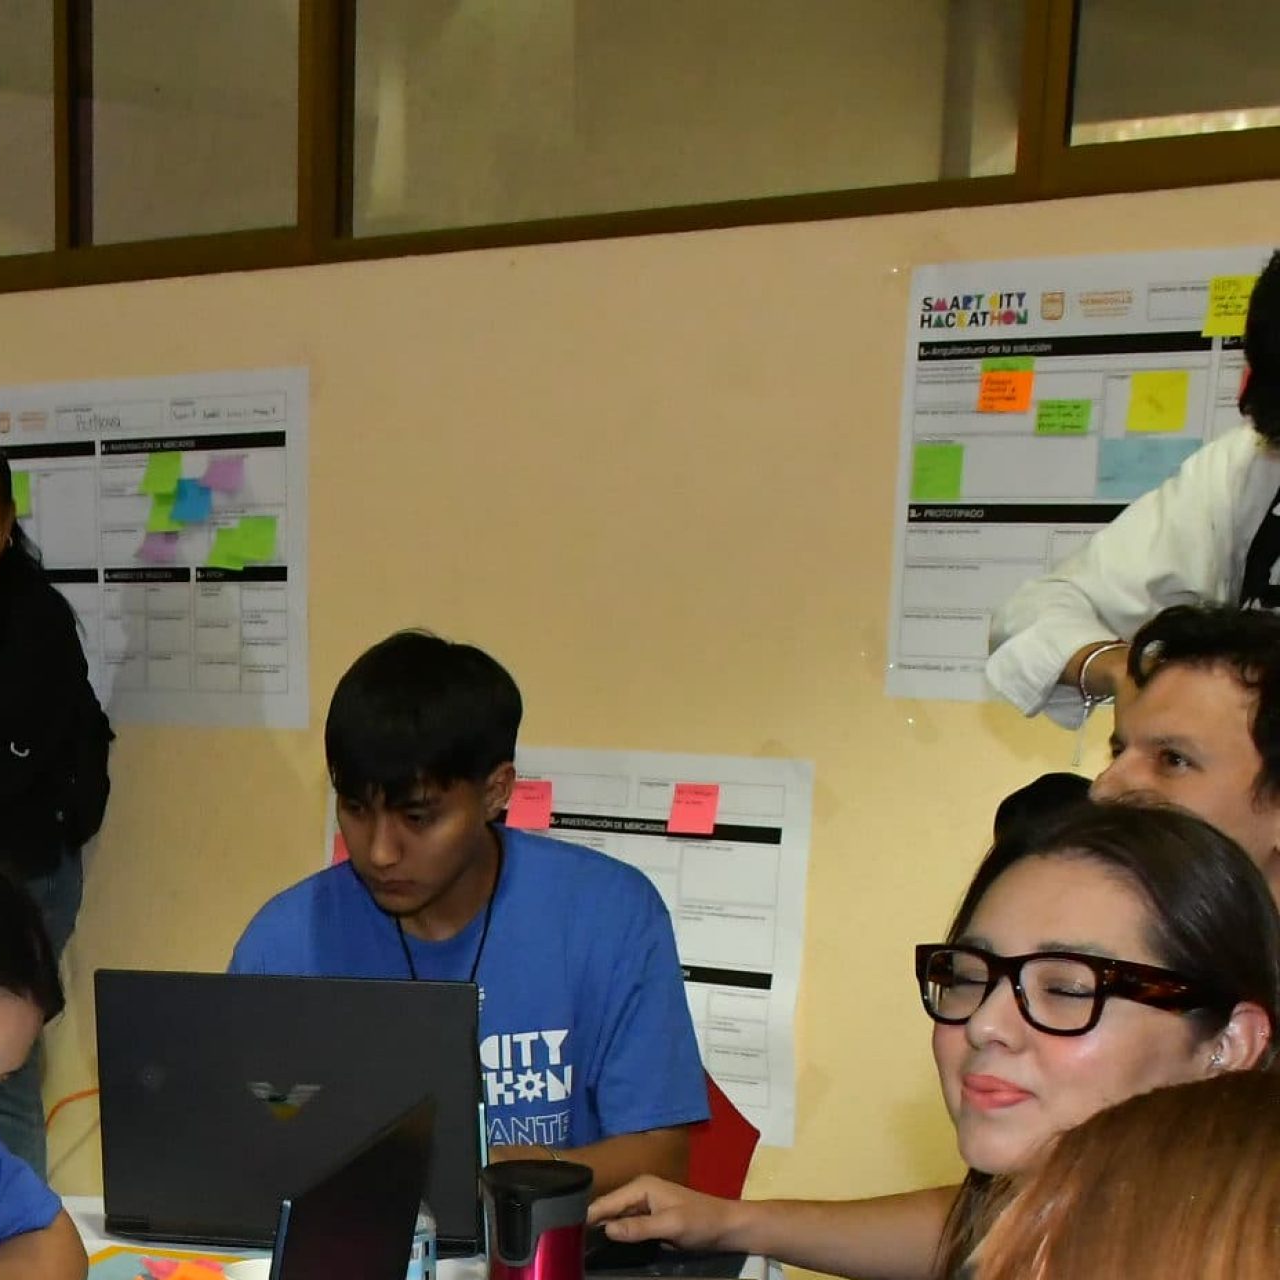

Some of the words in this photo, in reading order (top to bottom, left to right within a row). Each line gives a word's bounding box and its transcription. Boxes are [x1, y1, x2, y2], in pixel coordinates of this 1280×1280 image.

[922, 292, 984, 312] SMART
[987, 291, 1027, 309] CITY
[920, 309, 1029, 330] HACKATHON
[480, 1029, 569, 1070] CITY
